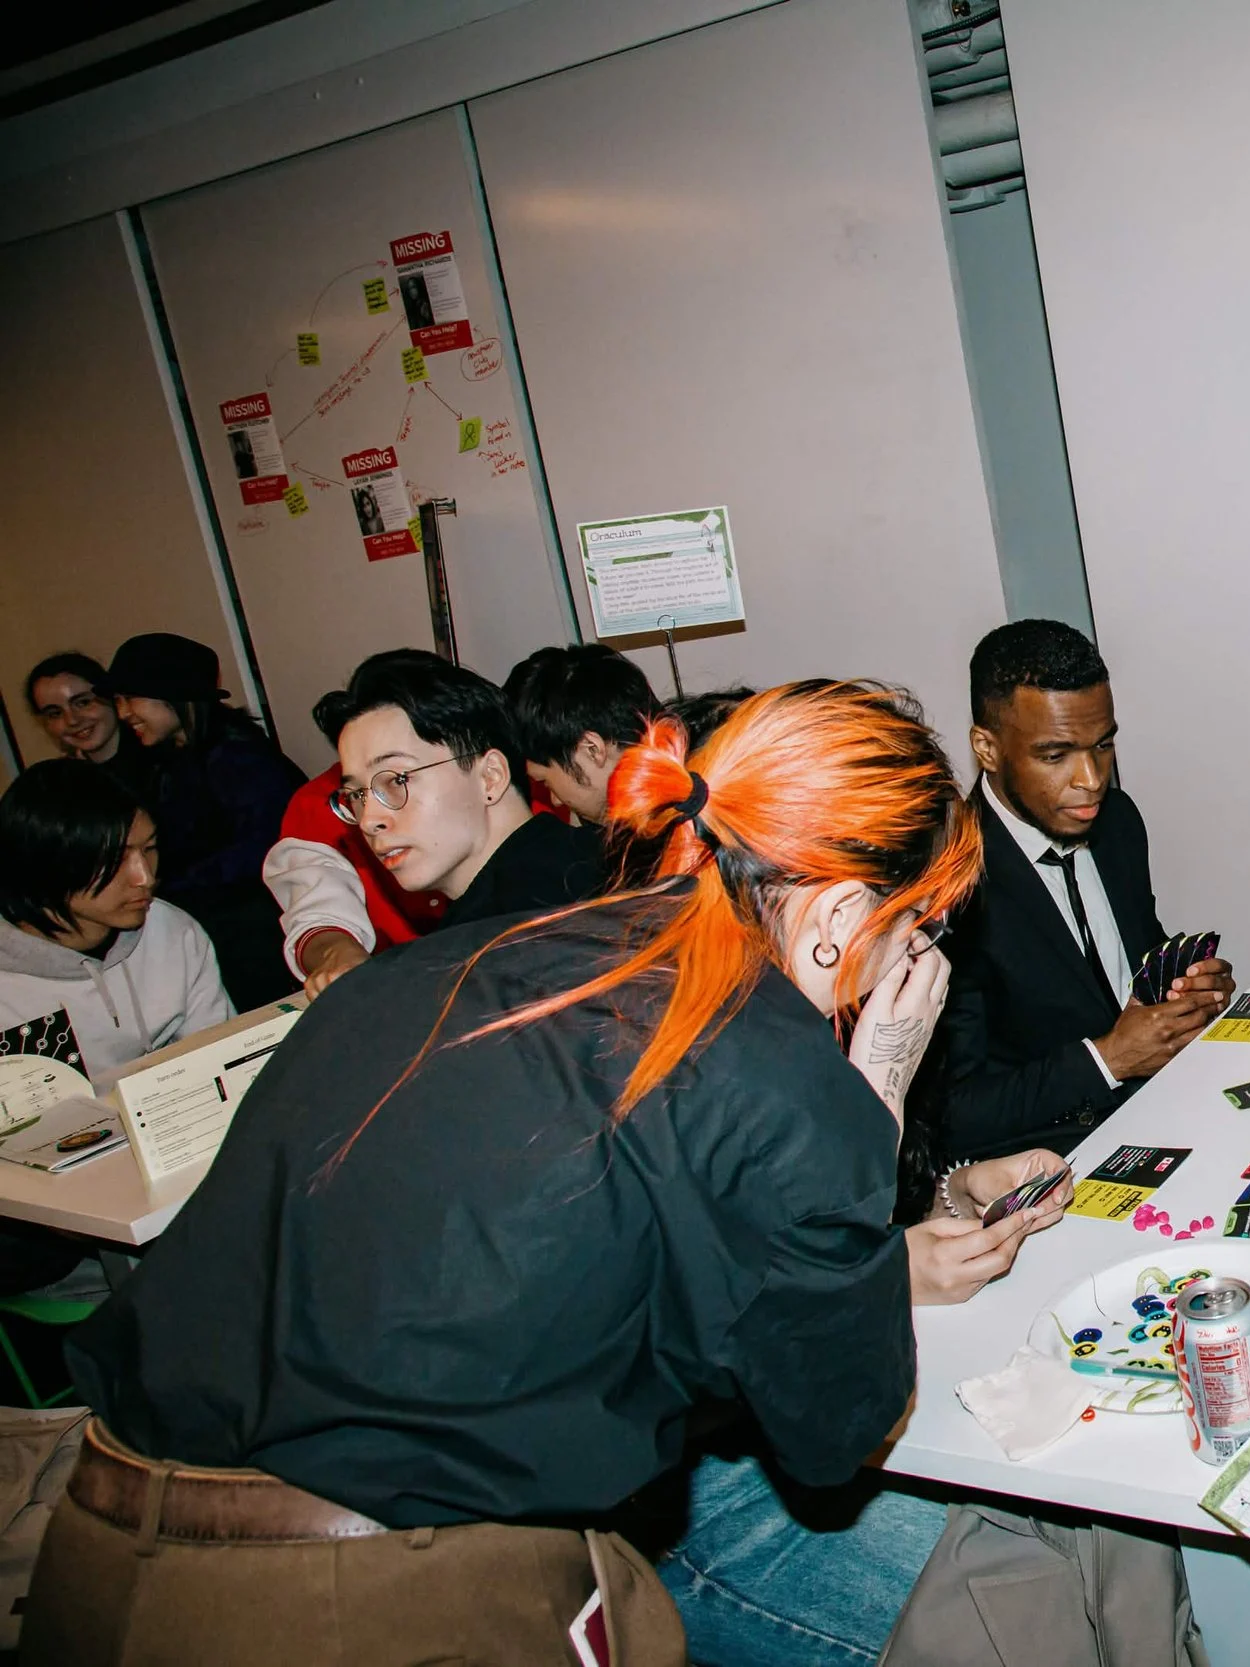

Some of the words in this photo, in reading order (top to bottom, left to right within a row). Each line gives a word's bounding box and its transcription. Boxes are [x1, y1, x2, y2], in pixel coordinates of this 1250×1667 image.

[394, 234, 446, 259] MISSING
[223, 400, 266, 419] MISSING
[346, 451, 392, 473] MISSING
[590, 528, 643, 542] Oraculum
